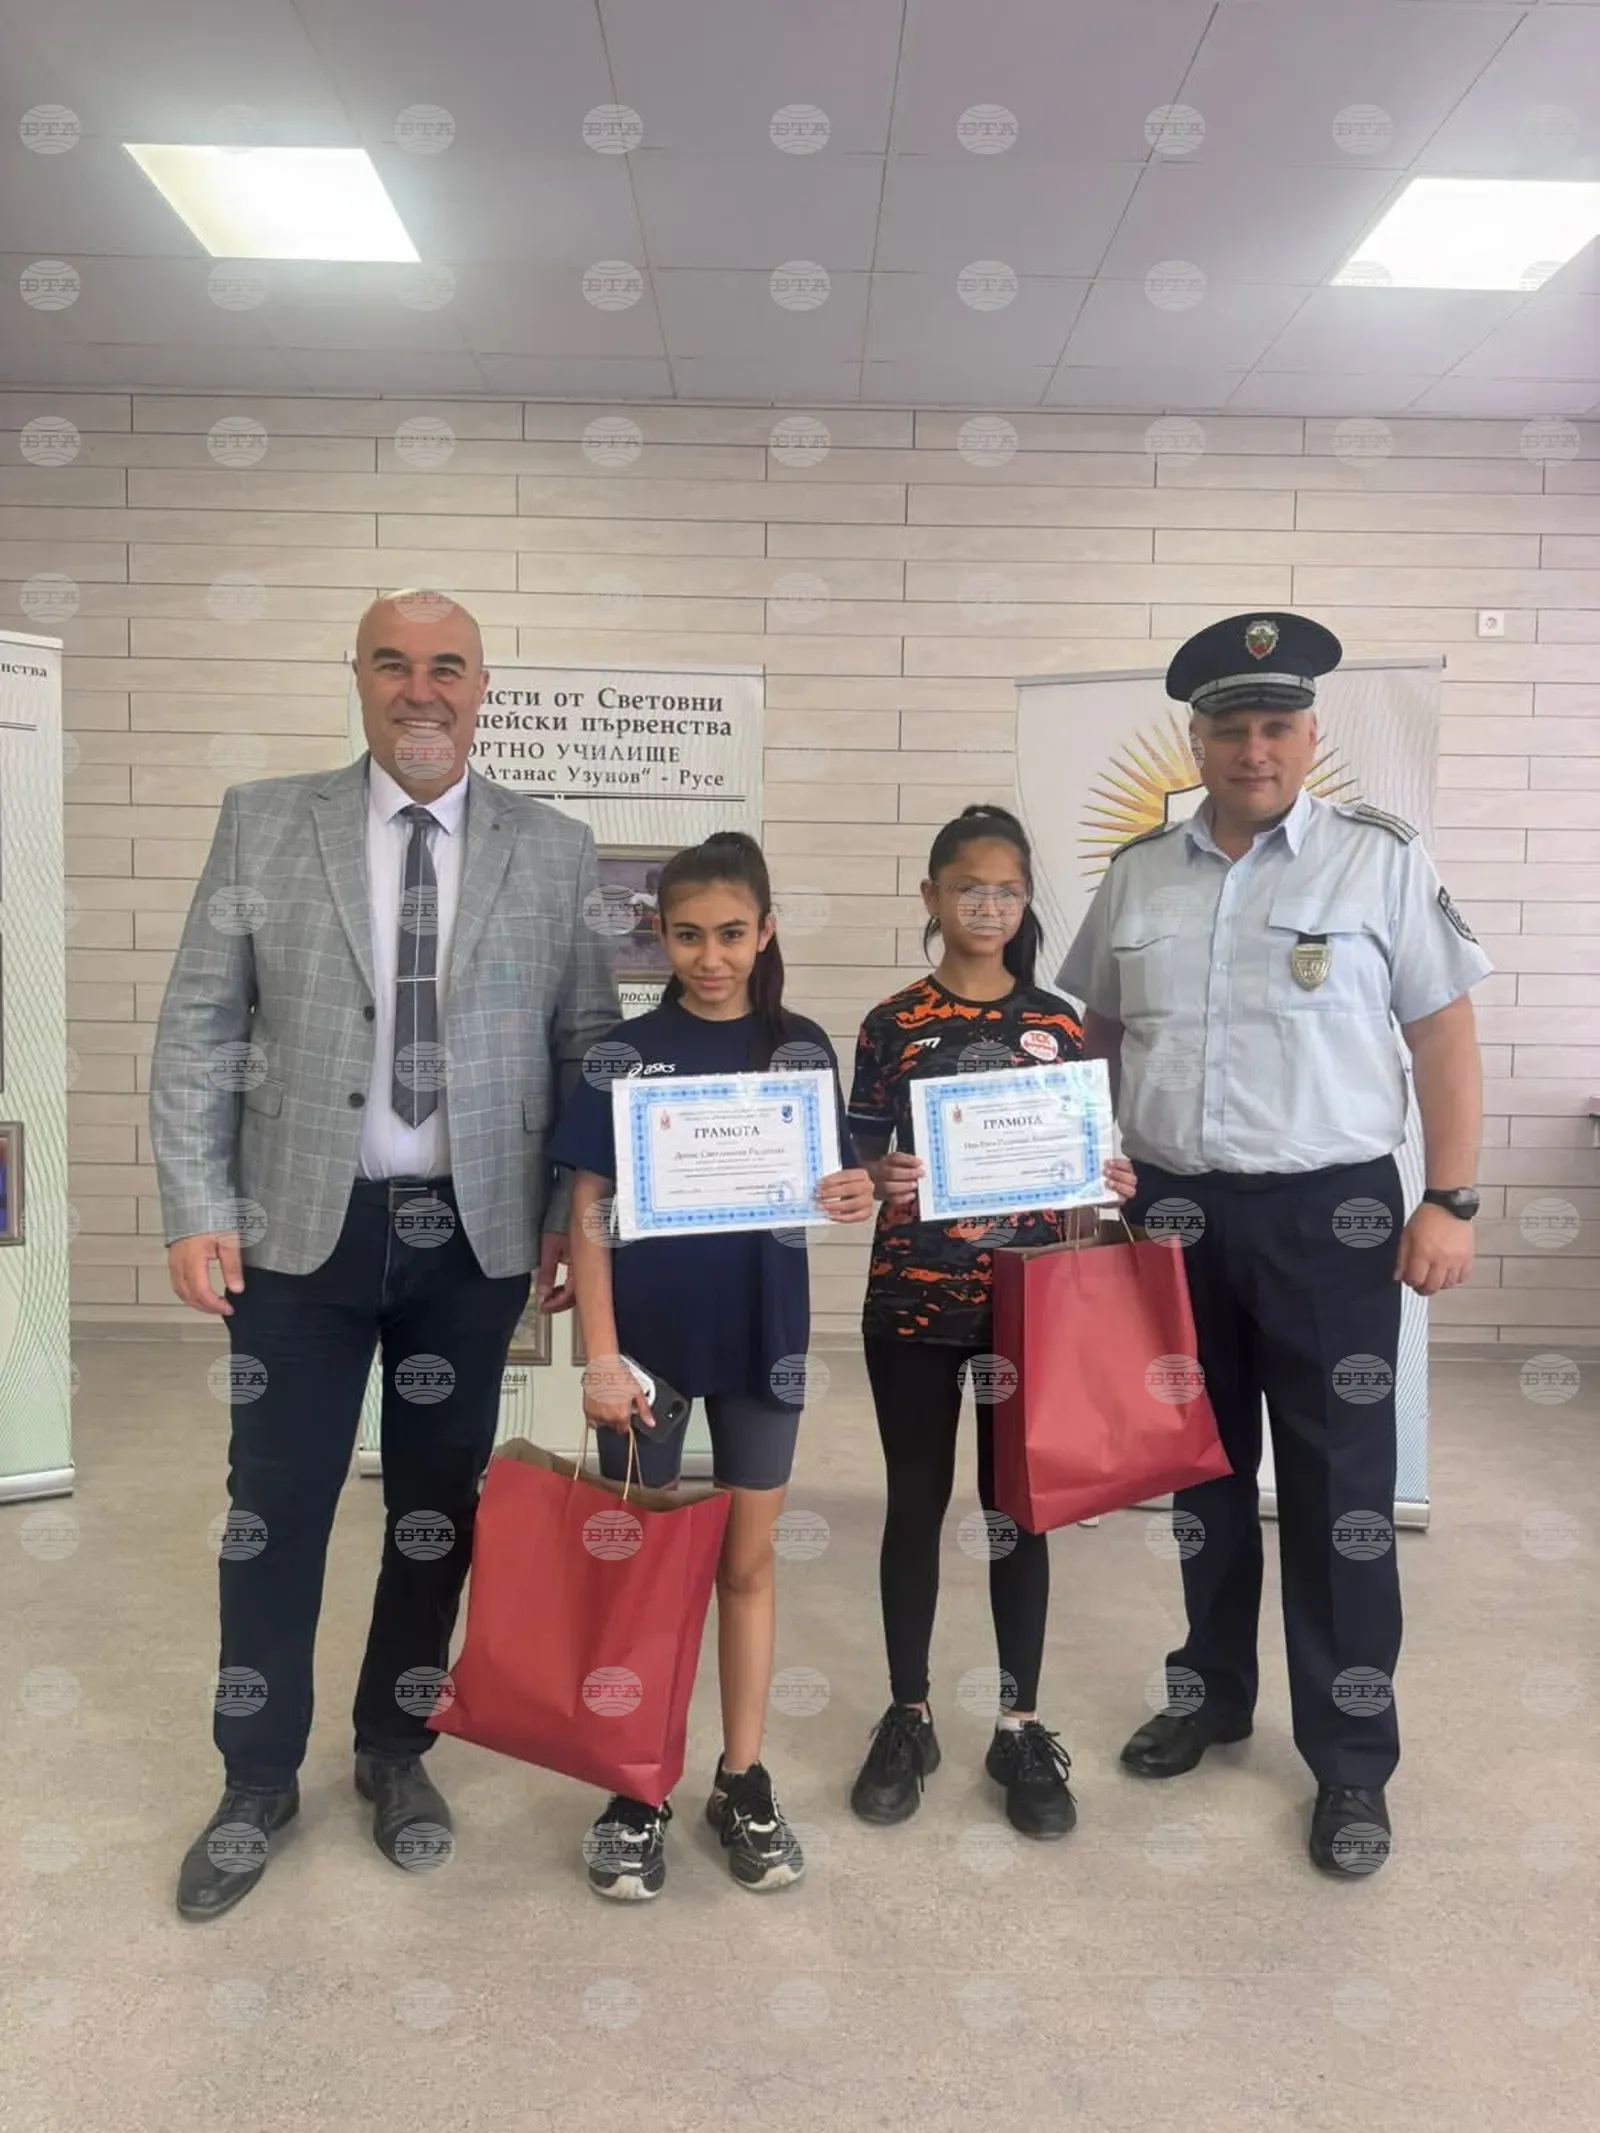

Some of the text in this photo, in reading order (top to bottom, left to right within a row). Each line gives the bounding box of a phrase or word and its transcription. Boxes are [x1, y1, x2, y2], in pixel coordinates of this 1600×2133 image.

[554, 692, 584, 707] от
[598, 687, 722, 712] Световни
[476, 711, 732, 739] пейски първенства
[557, 743, 681, 764] УЧИЛИЩЕ
[485, 764, 557, 781] Атанас
[680, 769, 724, 790] Русе
[694, 1125, 760, 1139] ГРАМОТА
